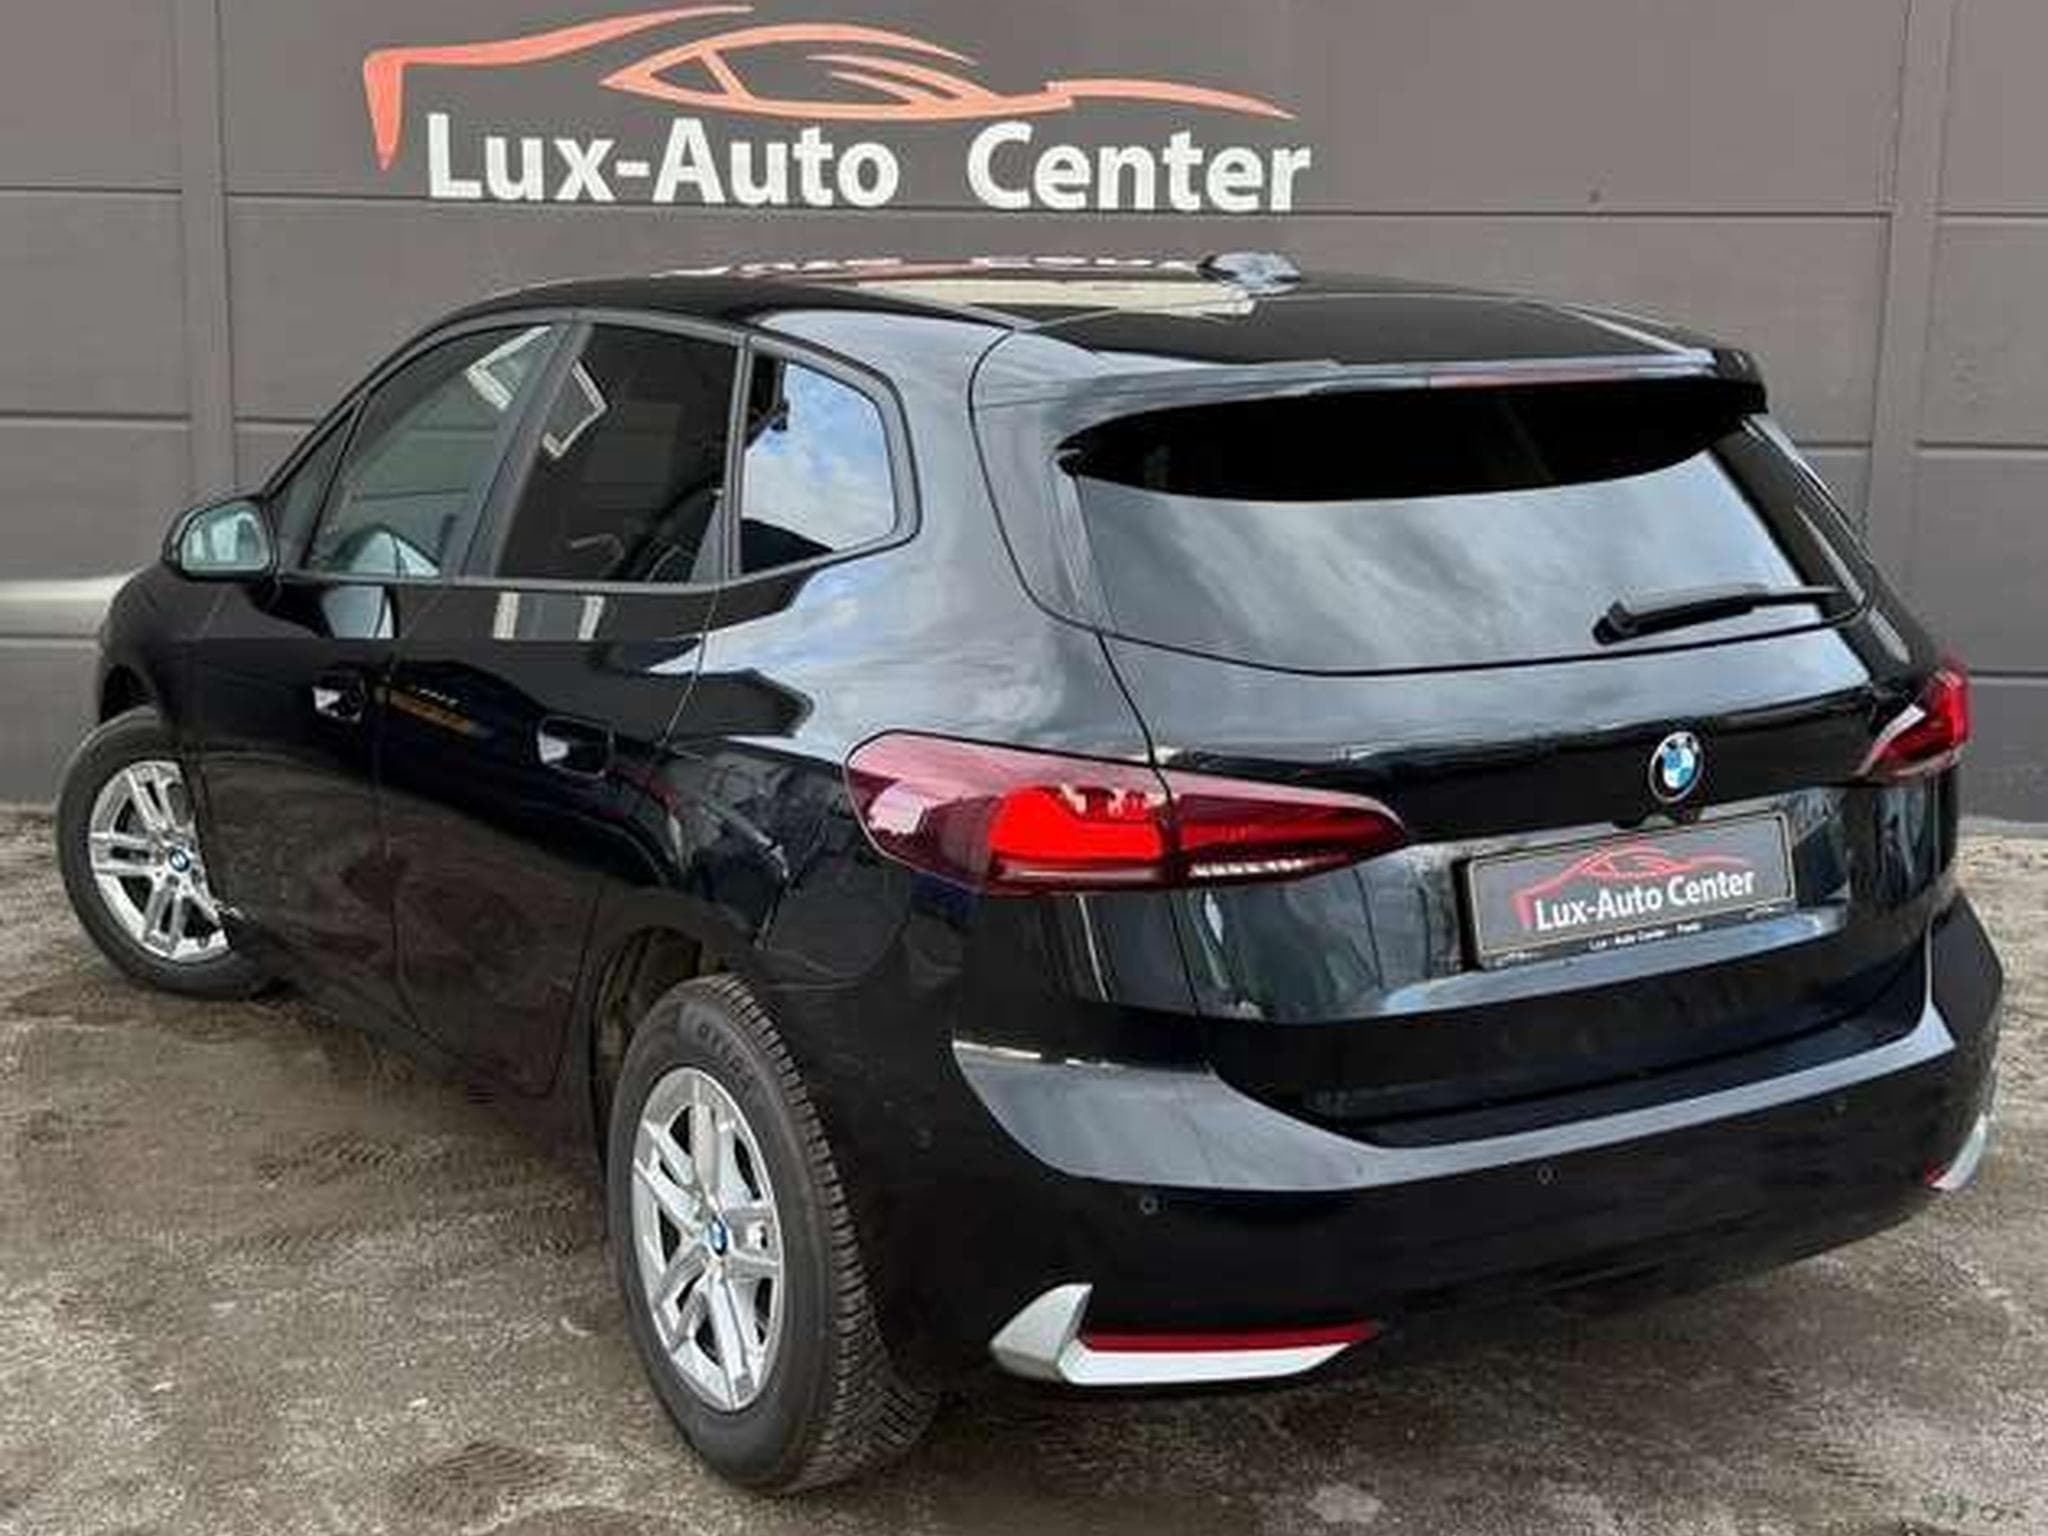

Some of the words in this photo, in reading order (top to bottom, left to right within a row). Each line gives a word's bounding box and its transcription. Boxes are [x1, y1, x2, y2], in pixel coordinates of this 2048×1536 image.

[427, 113, 900, 208] Lux-Auto
[966, 120, 1311, 212] Center
[1534, 886, 1663, 932] Lux-Auto
[1666, 871, 1755, 907] Center
